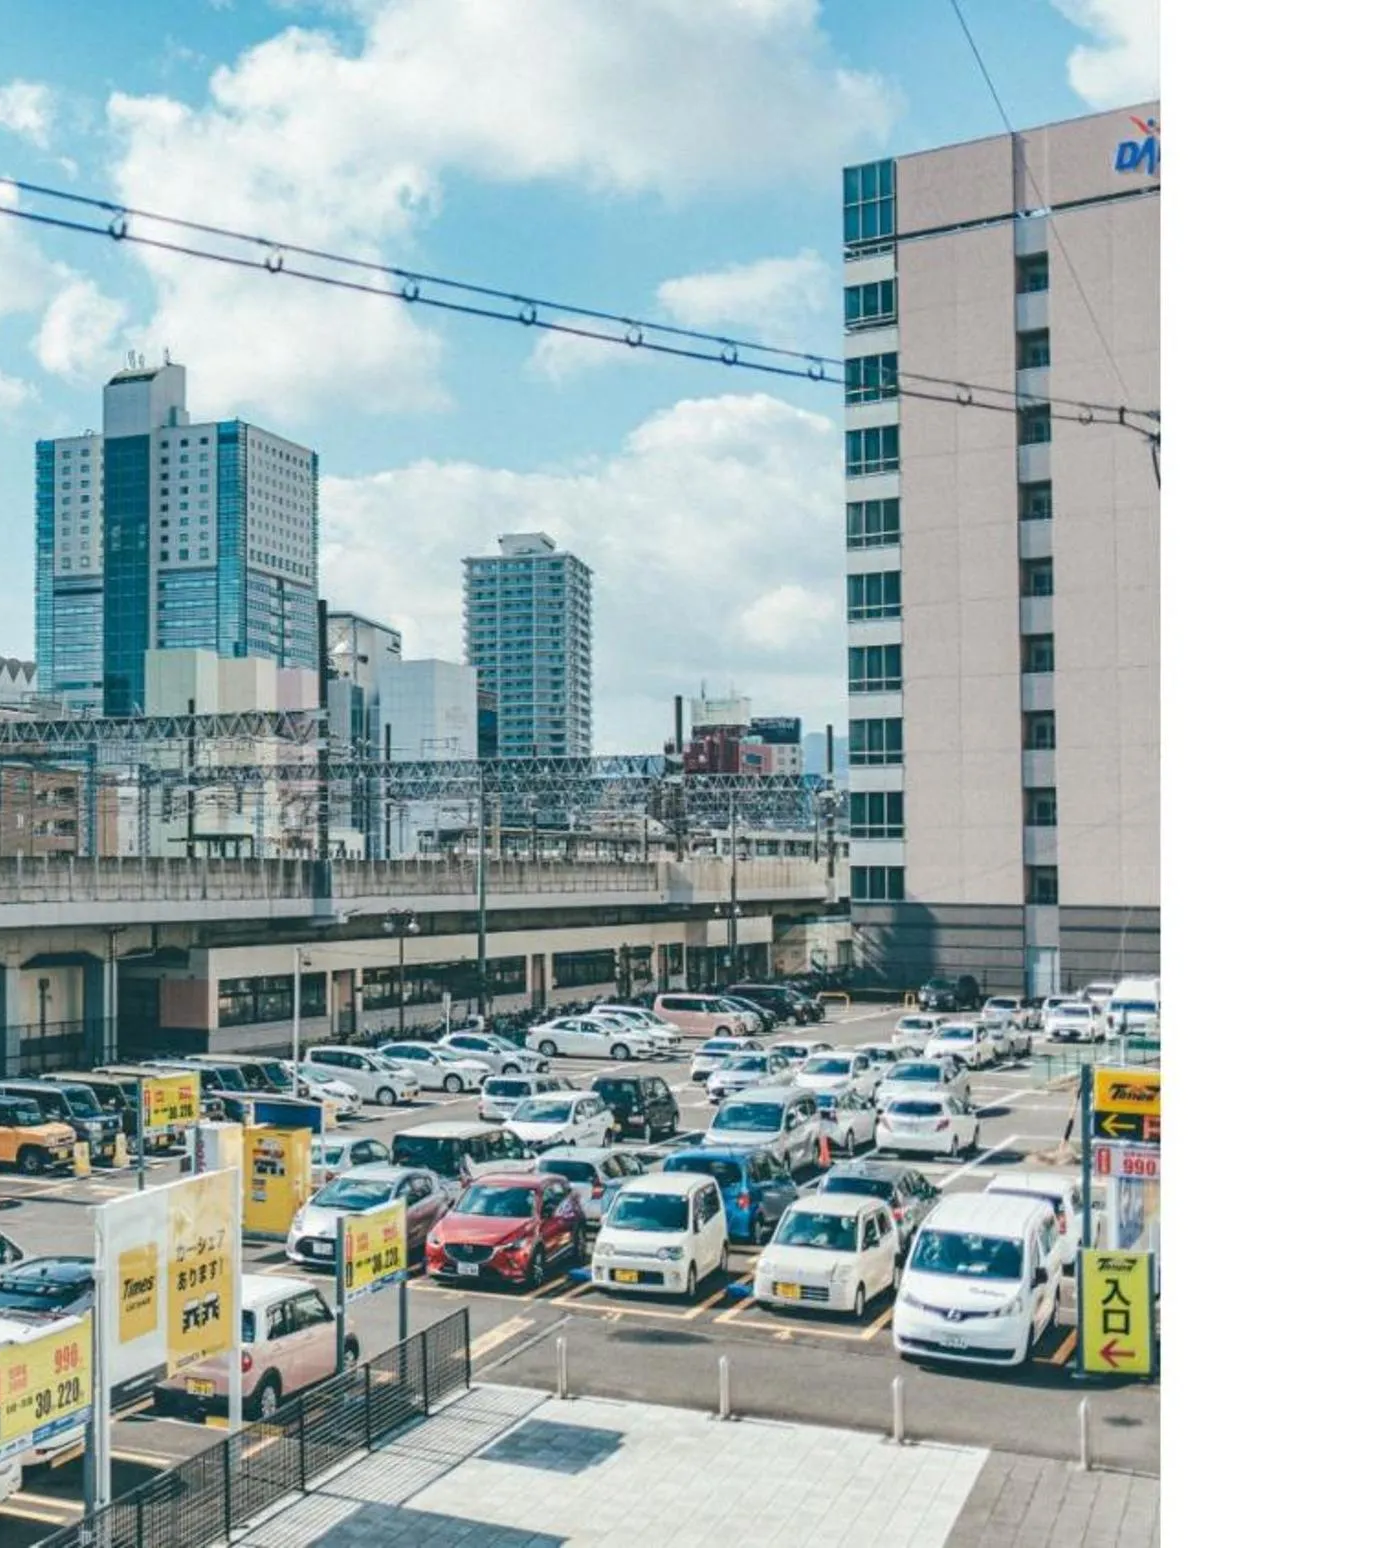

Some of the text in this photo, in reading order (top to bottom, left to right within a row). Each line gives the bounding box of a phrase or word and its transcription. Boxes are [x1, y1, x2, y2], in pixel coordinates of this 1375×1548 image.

[1114, 136, 1160, 175] DA
[1123, 1158, 1157, 1177] 990
[1101, 1278, 1131, 1335] 入口
[35, 1388, 52, 1419] 30
[58, 1376, 80, 1410] 220
